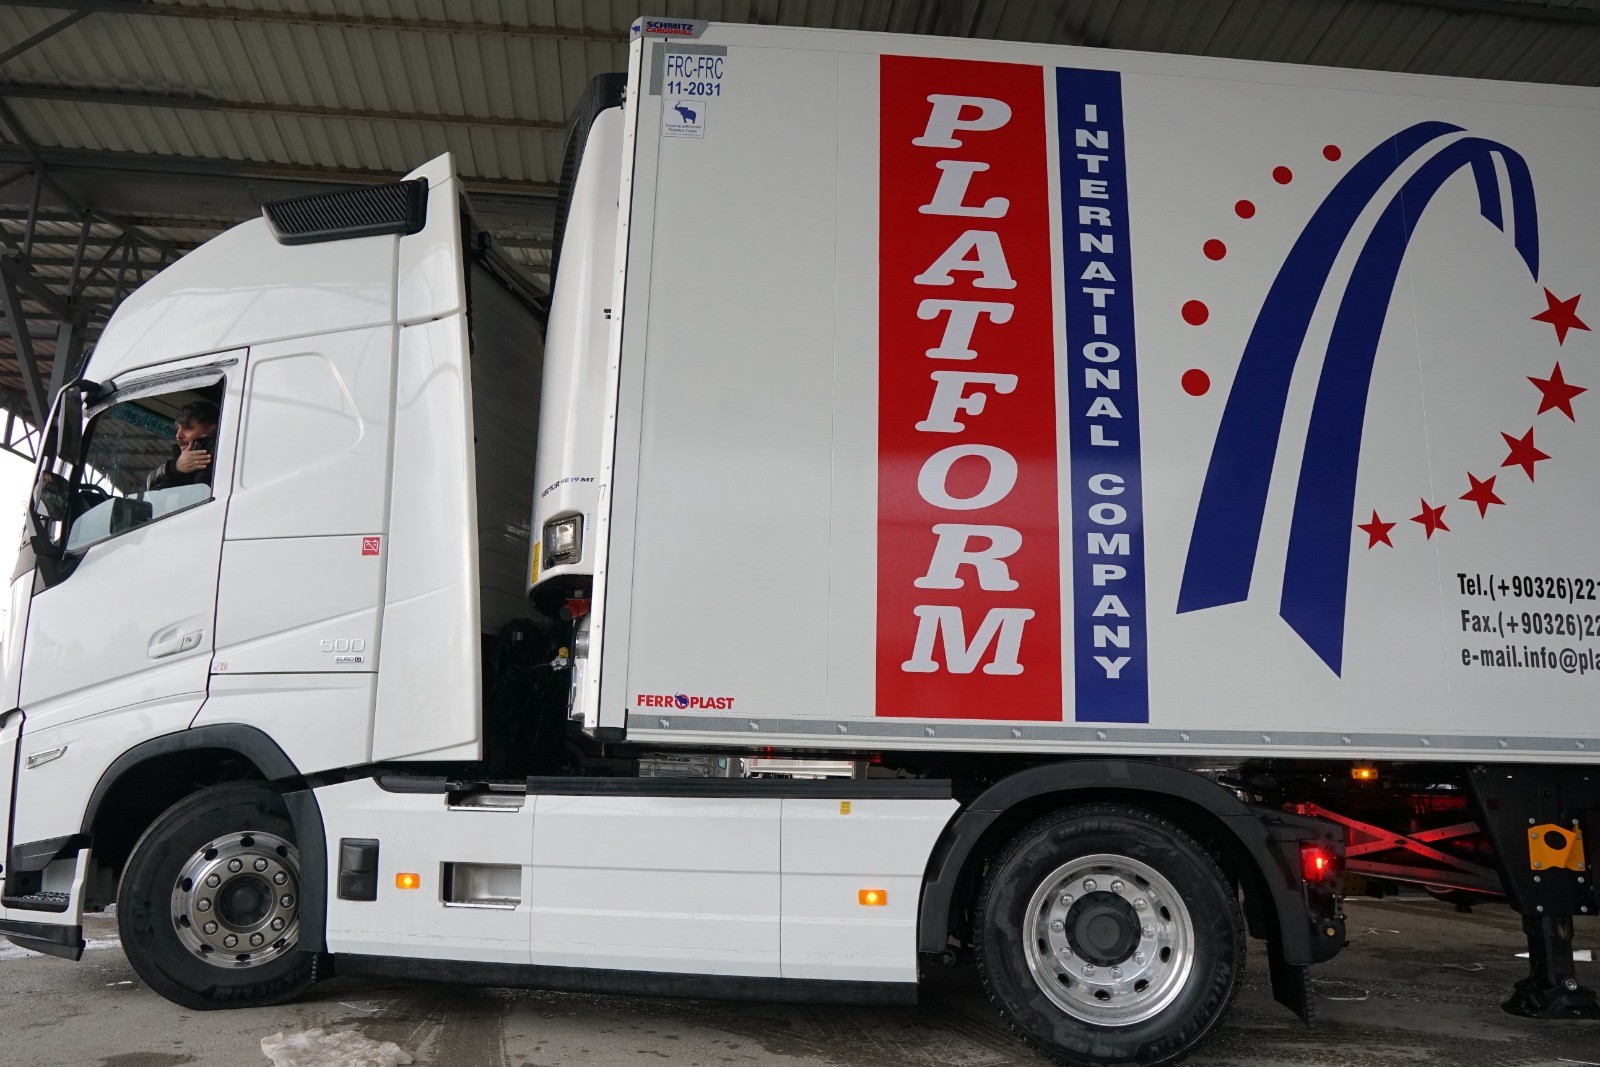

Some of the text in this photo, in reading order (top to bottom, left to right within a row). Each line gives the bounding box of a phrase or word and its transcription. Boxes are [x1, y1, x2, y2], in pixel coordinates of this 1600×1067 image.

[645, 27, 693, 36] CARGOBULL
[646, 21, 694, 31] SCHMITZ
[667, 55, 724, 79] FRC-FRC
[668, 81, 721, 96] 11-2031
[1075, 104, 1121, 447] INTERNATIONAL
[900, 93, 1036, 677] PLATFORM
[1087, 473, 1132, 679] COMPANY
[320, 638, 366, 653] 500
[637, 693, 735, 710] FERROPLAST
